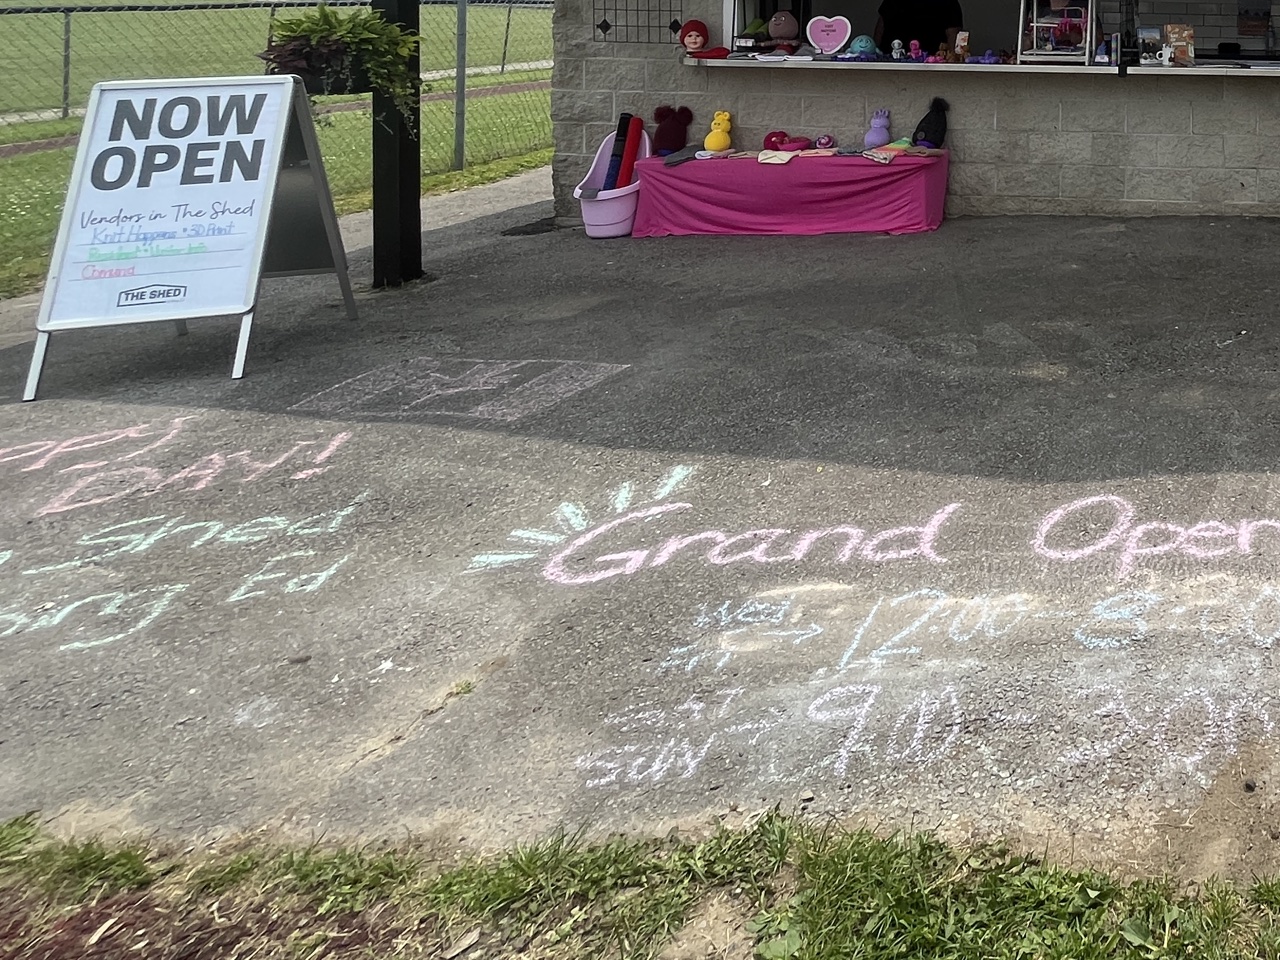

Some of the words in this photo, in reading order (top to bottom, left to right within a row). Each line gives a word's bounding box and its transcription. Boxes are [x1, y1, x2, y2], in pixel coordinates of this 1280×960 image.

[108, 93, 268, 142] NOW
[90, 139, 265, 191] OPEN
[81, 208, 145, 229] Vendors
[149, 210, 167, 222] in
[172, 204, 206, 222] The
[210, 199, 256, 219] Shed
[124, 291, 147, 302] THE
[149, 288, 181, 300] SHED
[541, 498, 961, 587] Grand
[227, 550, 353, 602] Ed
